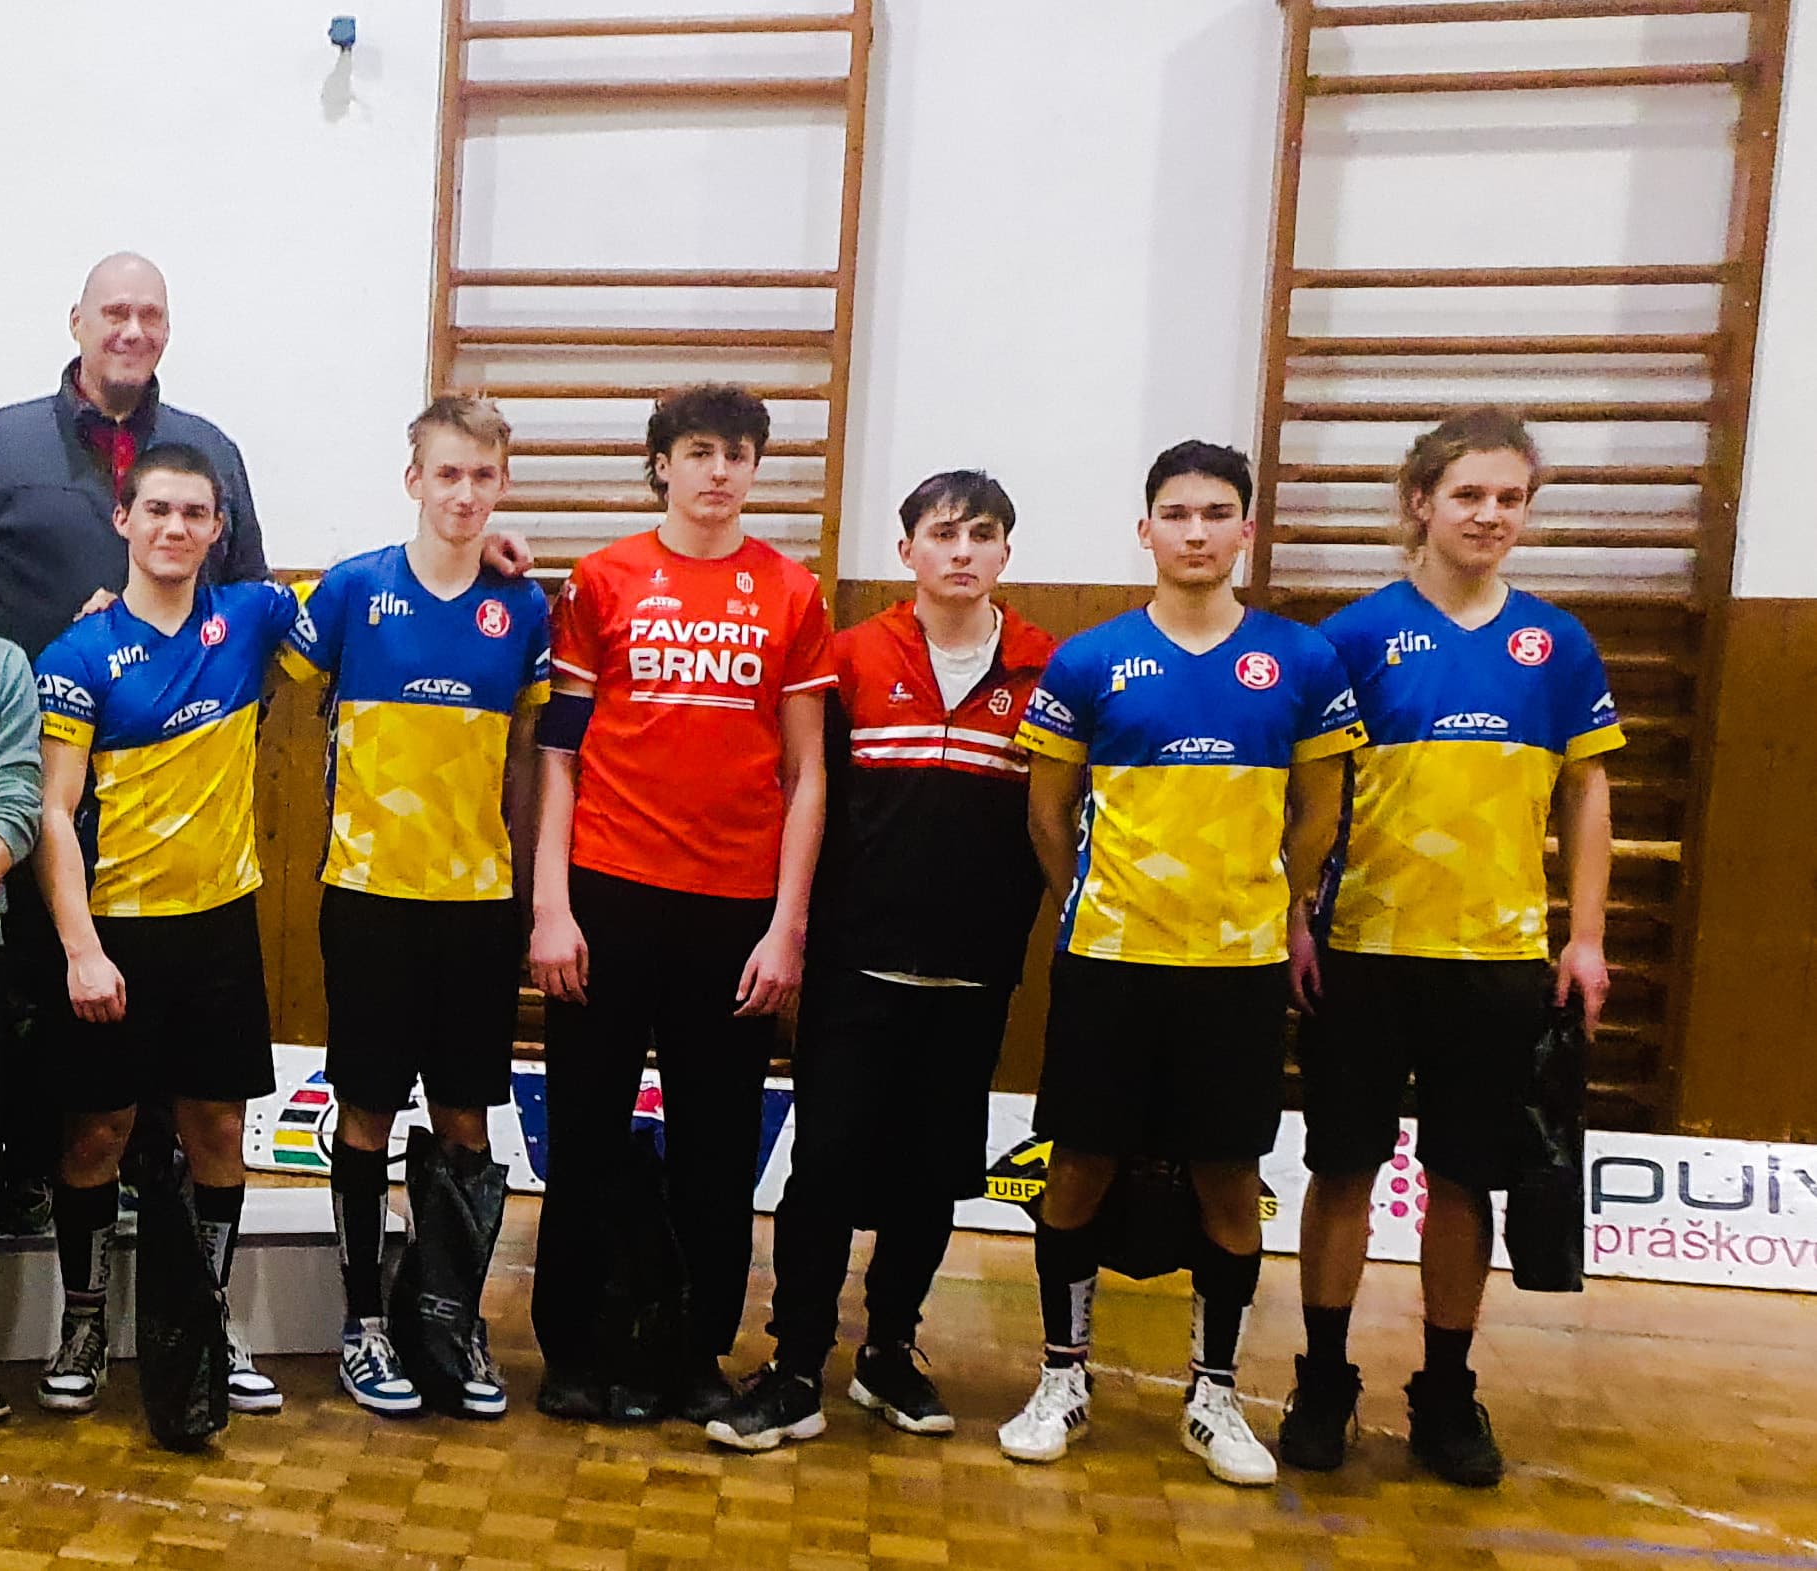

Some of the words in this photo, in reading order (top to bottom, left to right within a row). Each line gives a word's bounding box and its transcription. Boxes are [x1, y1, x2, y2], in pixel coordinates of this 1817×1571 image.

[629, 619, 770, 649] FAVORIT
[628, 647, 763, 687] BRNO
[1591, 1216, 1817, 1266] práškov
